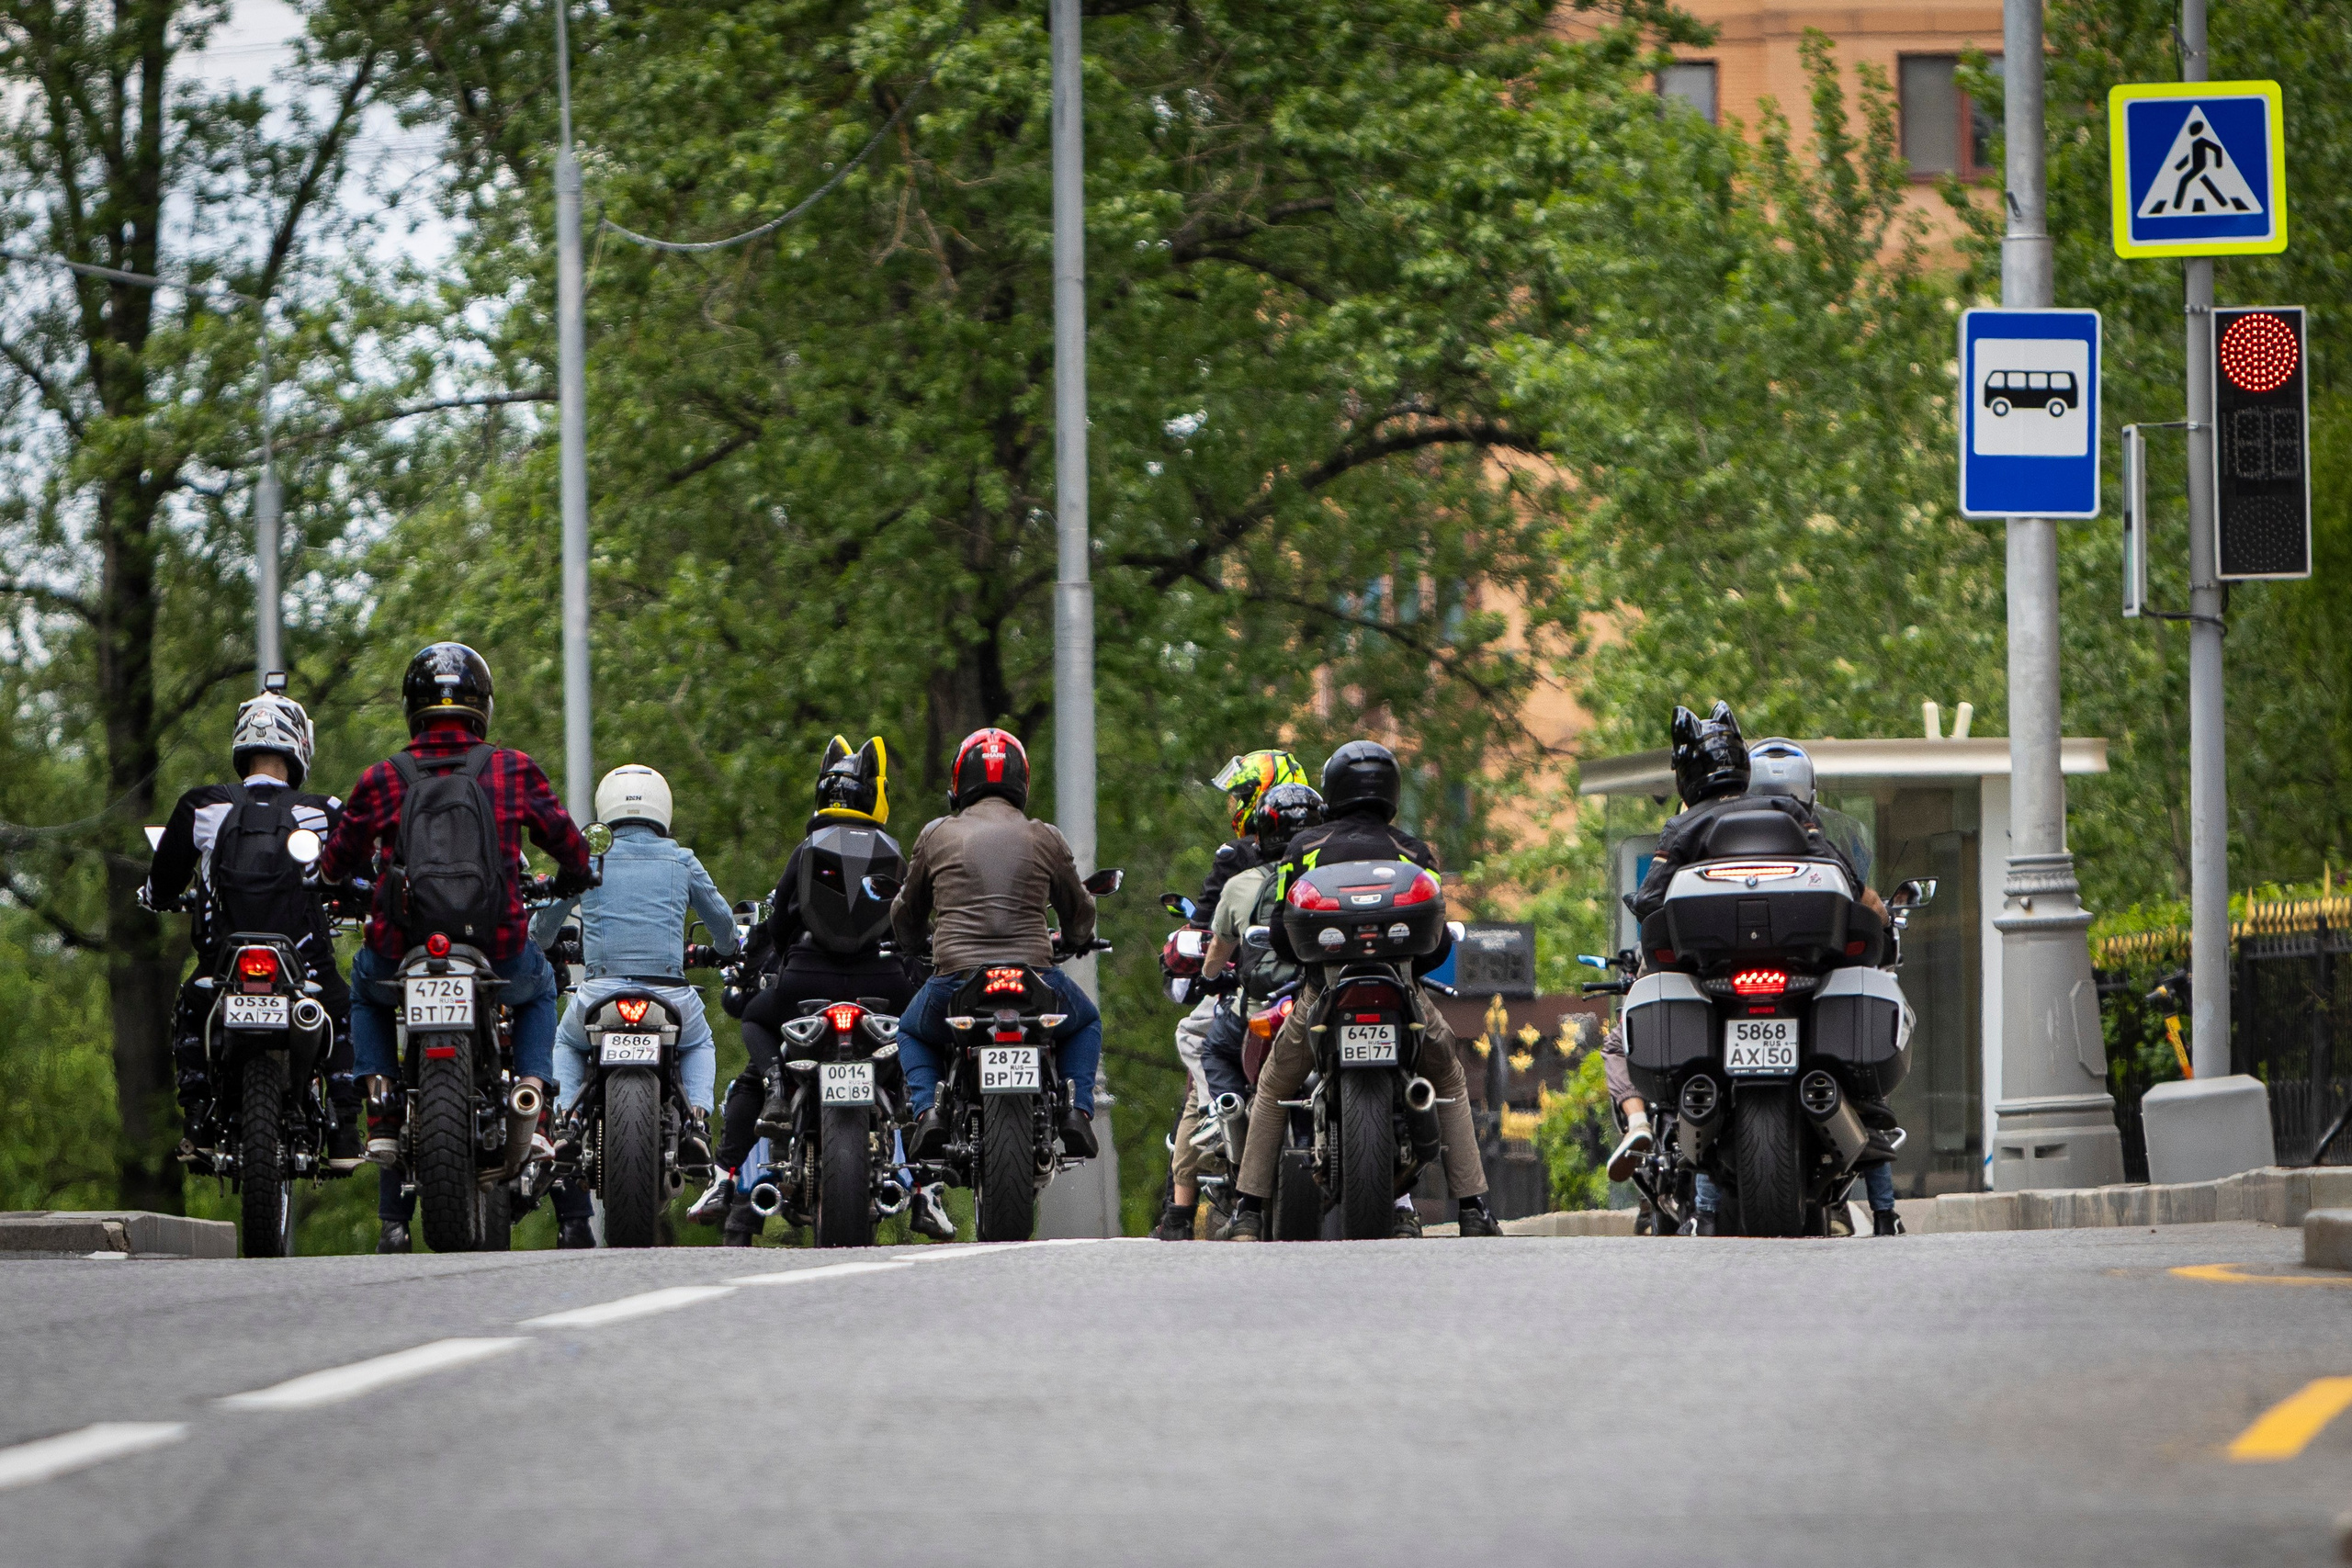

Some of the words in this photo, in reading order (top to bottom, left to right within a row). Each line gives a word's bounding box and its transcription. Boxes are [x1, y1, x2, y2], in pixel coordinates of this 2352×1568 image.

[415, 980, 463, 997] 4726
[234, 997, 279, 1007] 0536
[262, 1012, 283, 1021] 77
[445, 1005, 468, 1021] 77
[1348, 1027, 1388, 1040] 6476
[1737, 1023, 1786, 1040] 5868
[612, 1035, 650, 1045] 8686
[637, 1049, 655, 1060] 77
[988, 1051, 1031, 1064] 2872
[1374, 1046, 1392, 1058] 77
[1768, 1048, 1792, 1065] 50
[829, 1066, 865, 1079] 0014
[1014, 1071, 1034, 1085] 77
[852, 1086, 870, 1099] 89
